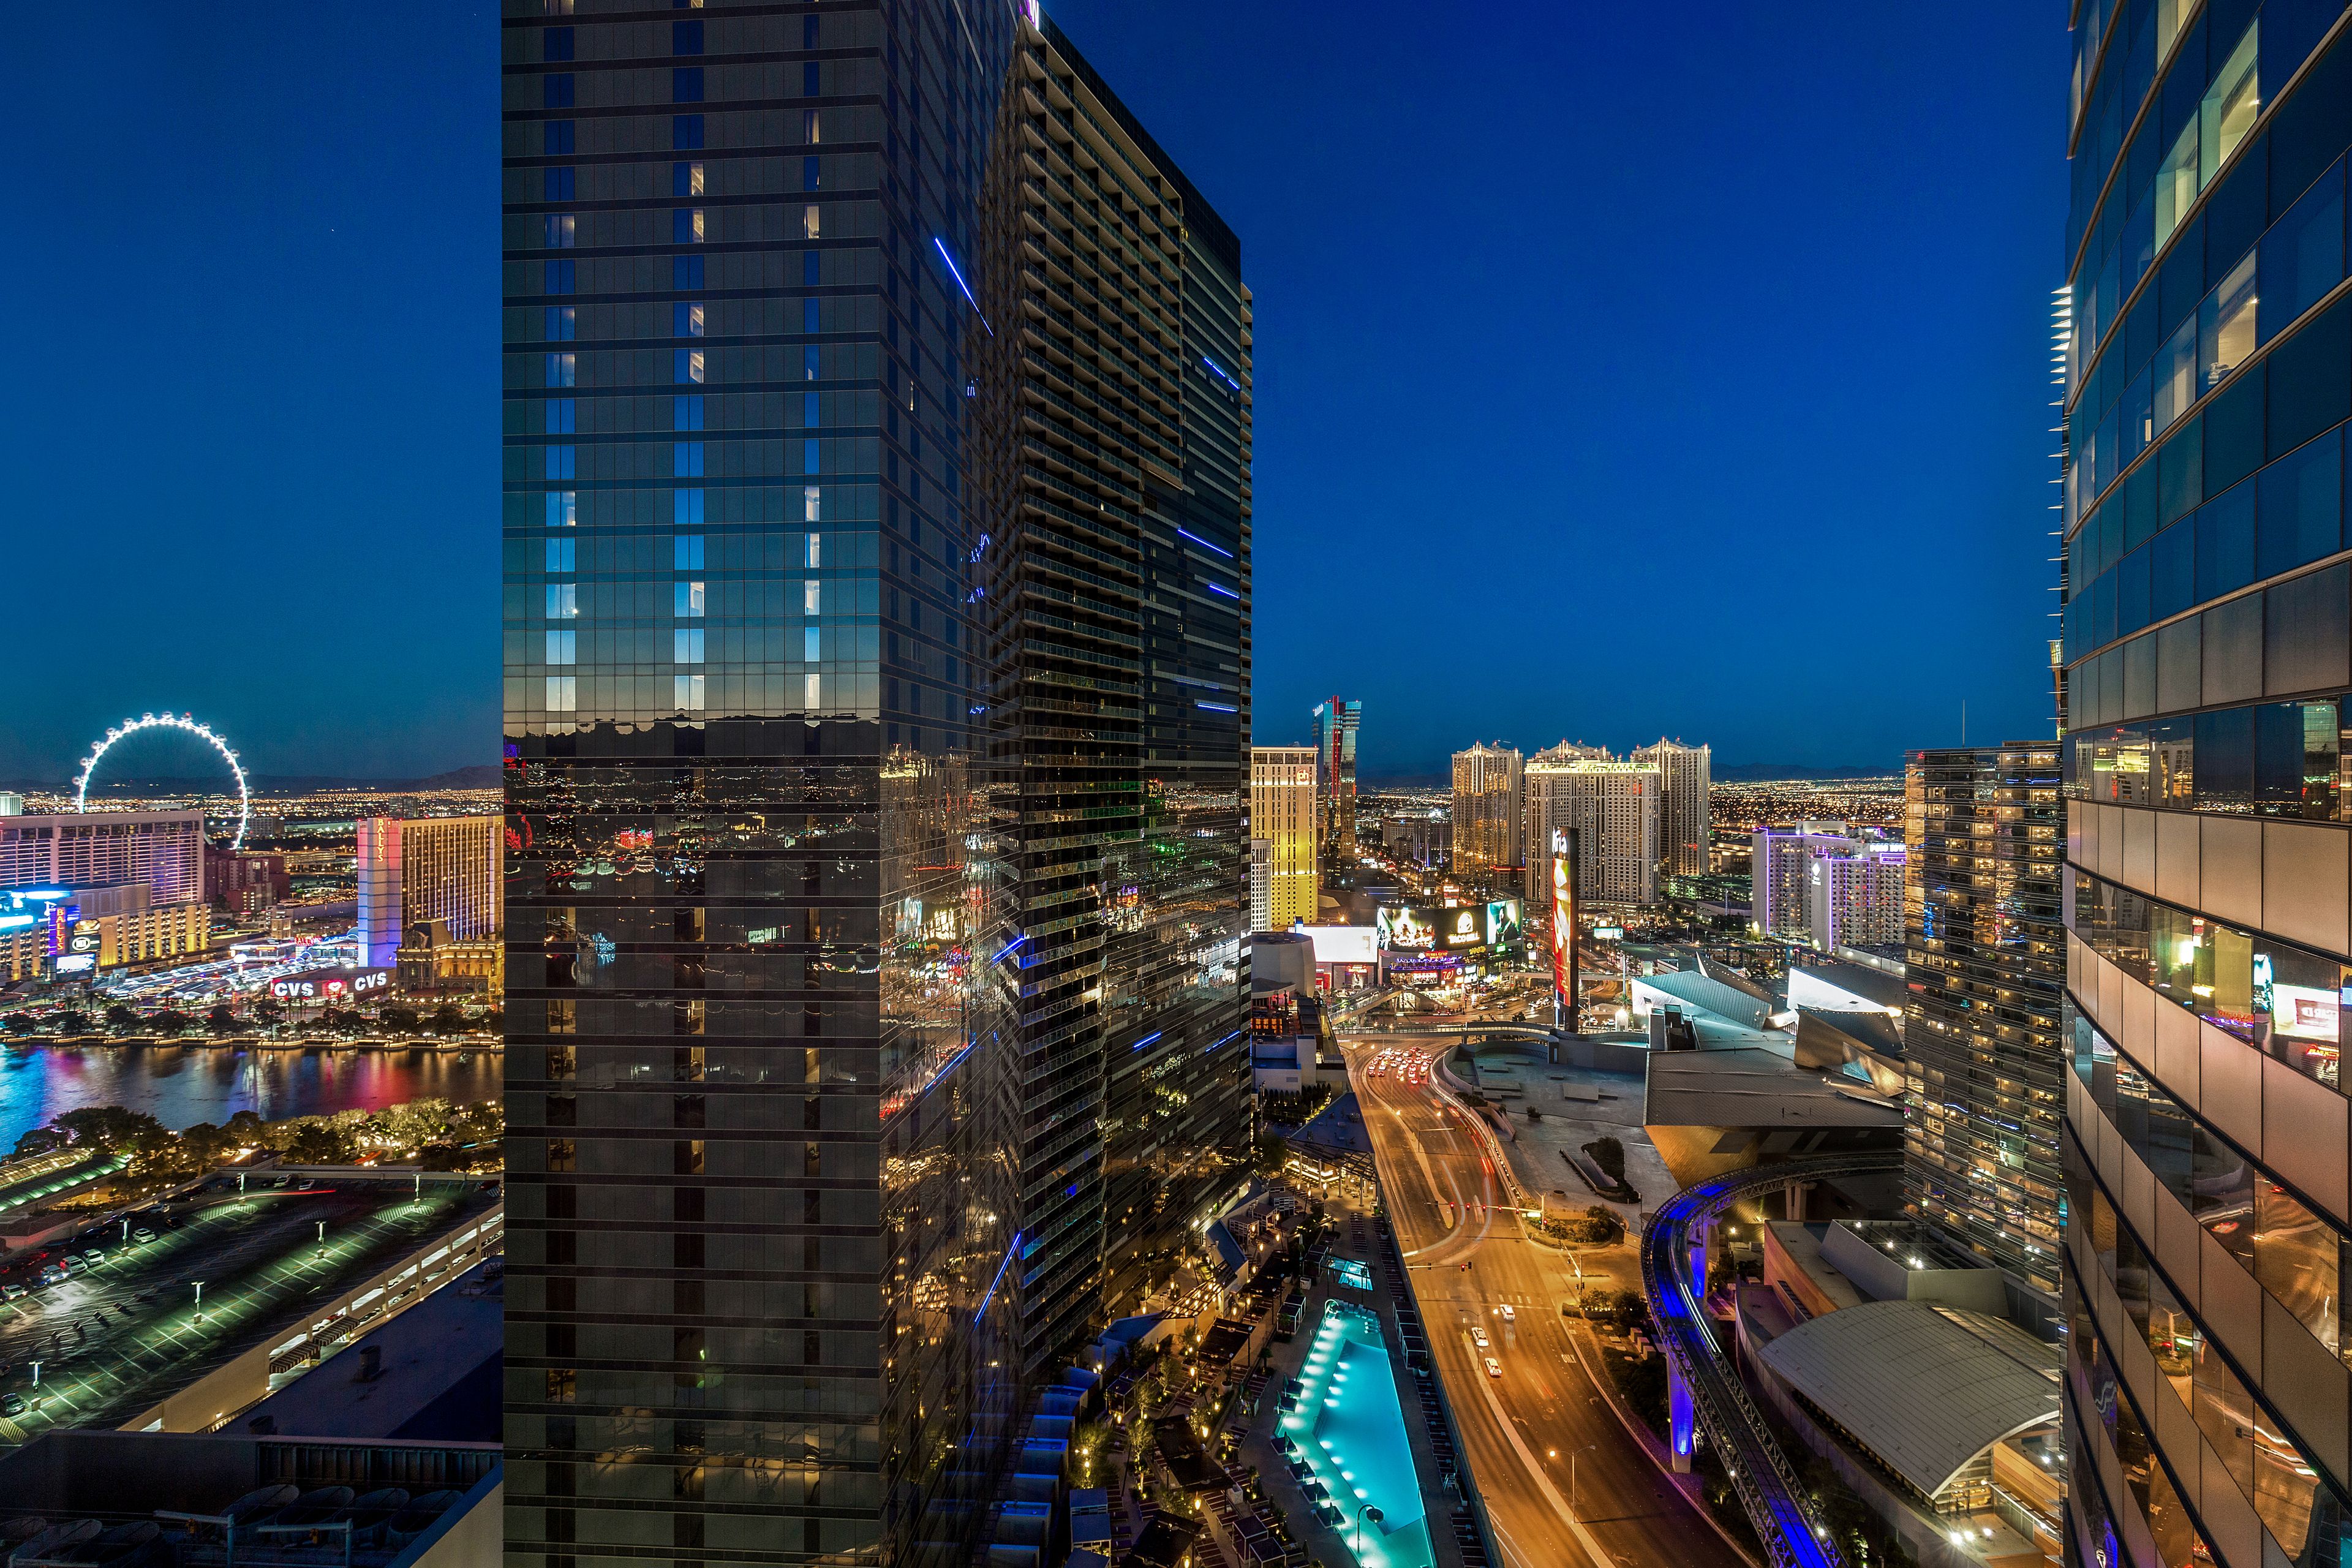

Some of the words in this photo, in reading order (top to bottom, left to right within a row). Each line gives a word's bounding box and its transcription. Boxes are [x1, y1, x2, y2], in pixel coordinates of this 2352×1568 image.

[1448, 933, 1466, 944] TACO
[1466, 931, 1480, 942] BELL
[355, 972, 386, 991] CVS
[274, 982, 314, 997] CVS
